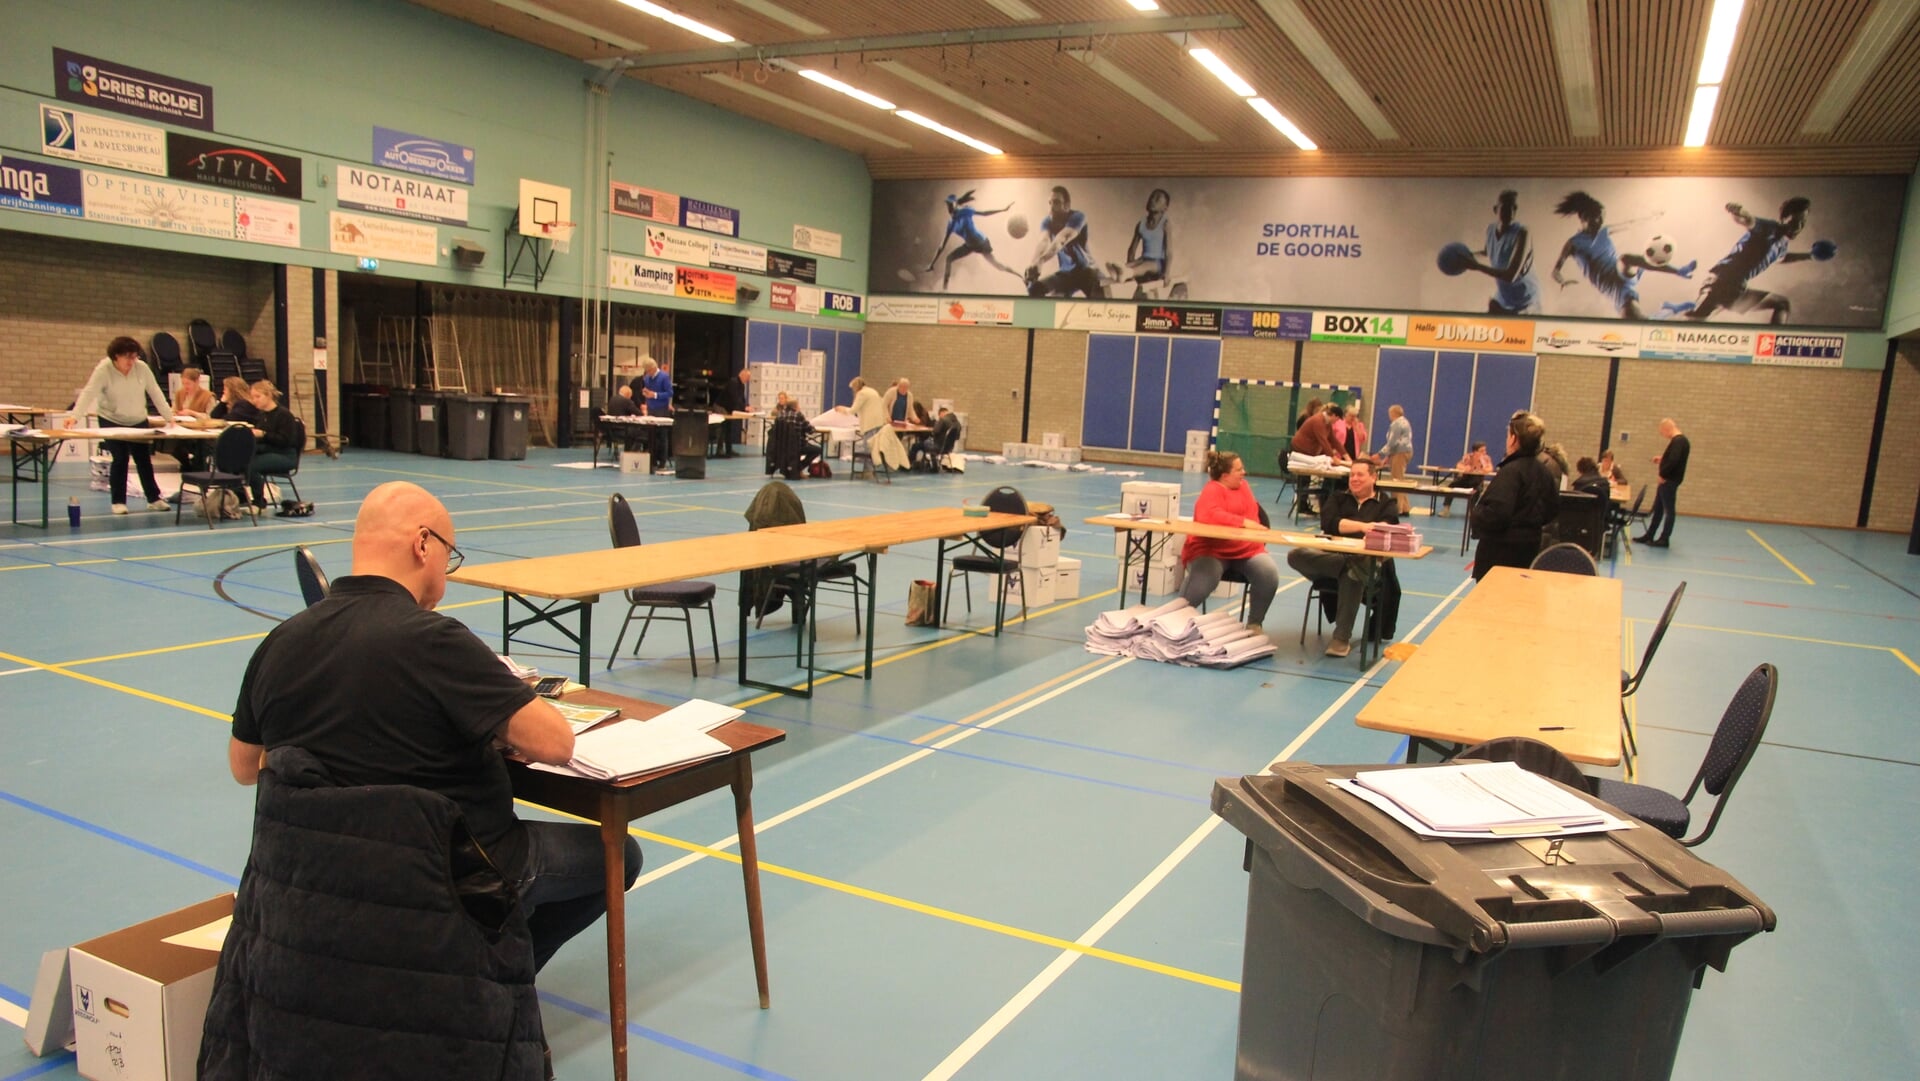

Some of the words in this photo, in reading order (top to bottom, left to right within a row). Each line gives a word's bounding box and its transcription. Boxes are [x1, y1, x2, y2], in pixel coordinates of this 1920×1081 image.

[98, 76, 146, 100] DRIES
[148, 88, 198, 112] ROLDE
[94, 141, 161, 155] ADVIESBUREAU
[198, 153, 274, 182] STYLE
[87, 174, 166, 198] OPTIEK
[178, 188, 230, 208] VISIE
[197, 174, 215, 184] HAIR
[218, 177, 276, 193] PROFESSIONALS
[350, 170, 456, 203] NOTARIAAT
[1263, 224, 1359, 238] SPORTHAL
[667, 236, 687, 246] Nassau
[688, 240, 708, 251] College
[1257, 242, 1280, 256] DE
[1284, 243, 1362, 258] GOORNS
[634, 265, 674, 284] Kamping
[832, 294, 853, 311] ROB
[1252, 311, 1280, 328] HOB
[1324, 316, 1394, 335] BOX14
[1253, 330, 1277, 338] Gieten
[1435, 323, 1504, 343] JUMBO
[1677, 333, 1738, 345] NAMACO
[1776, 336, 1842, 348] ACTIONCENTER
